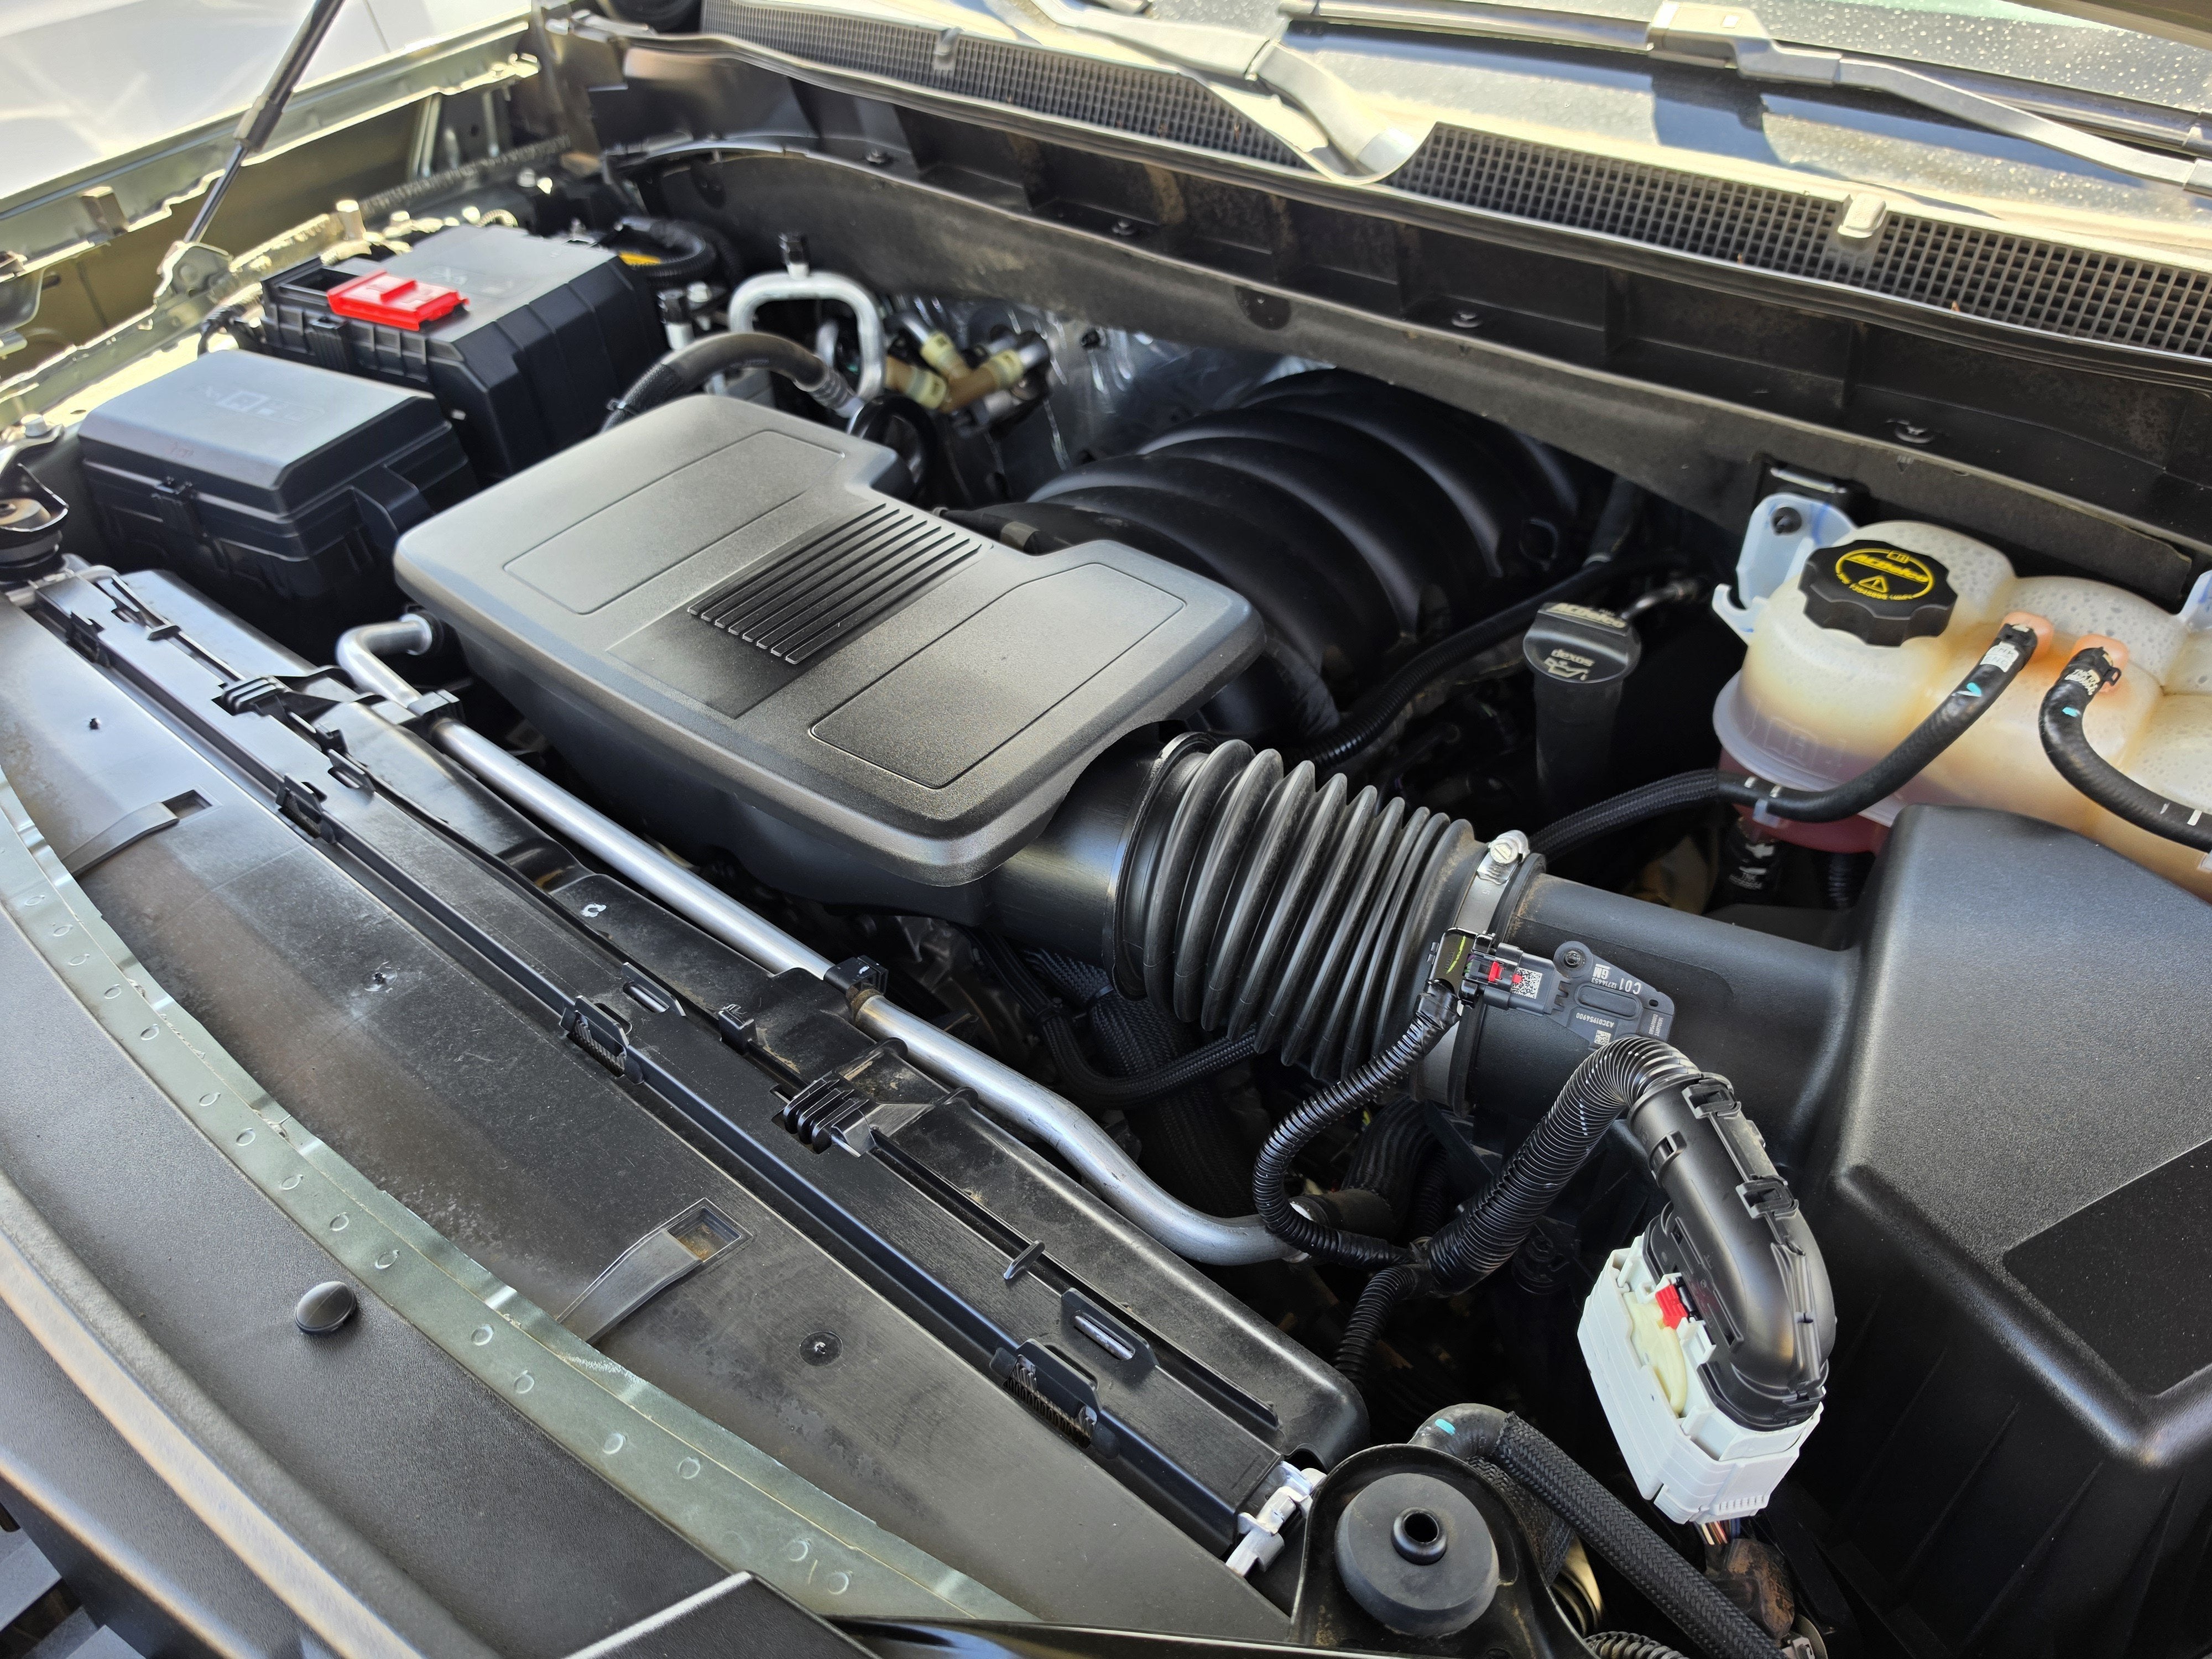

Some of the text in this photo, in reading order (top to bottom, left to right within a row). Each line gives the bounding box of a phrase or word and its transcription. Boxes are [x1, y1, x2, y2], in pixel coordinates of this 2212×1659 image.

[1848, 554, 1930, 582] ACDelco
[1547, 603, 1627, 628] ACDelco
[1551, 649, 1595, 667] dexos
[1593, 966, 1610, 980] GM
[1619, 978, 1641, 995] C01
